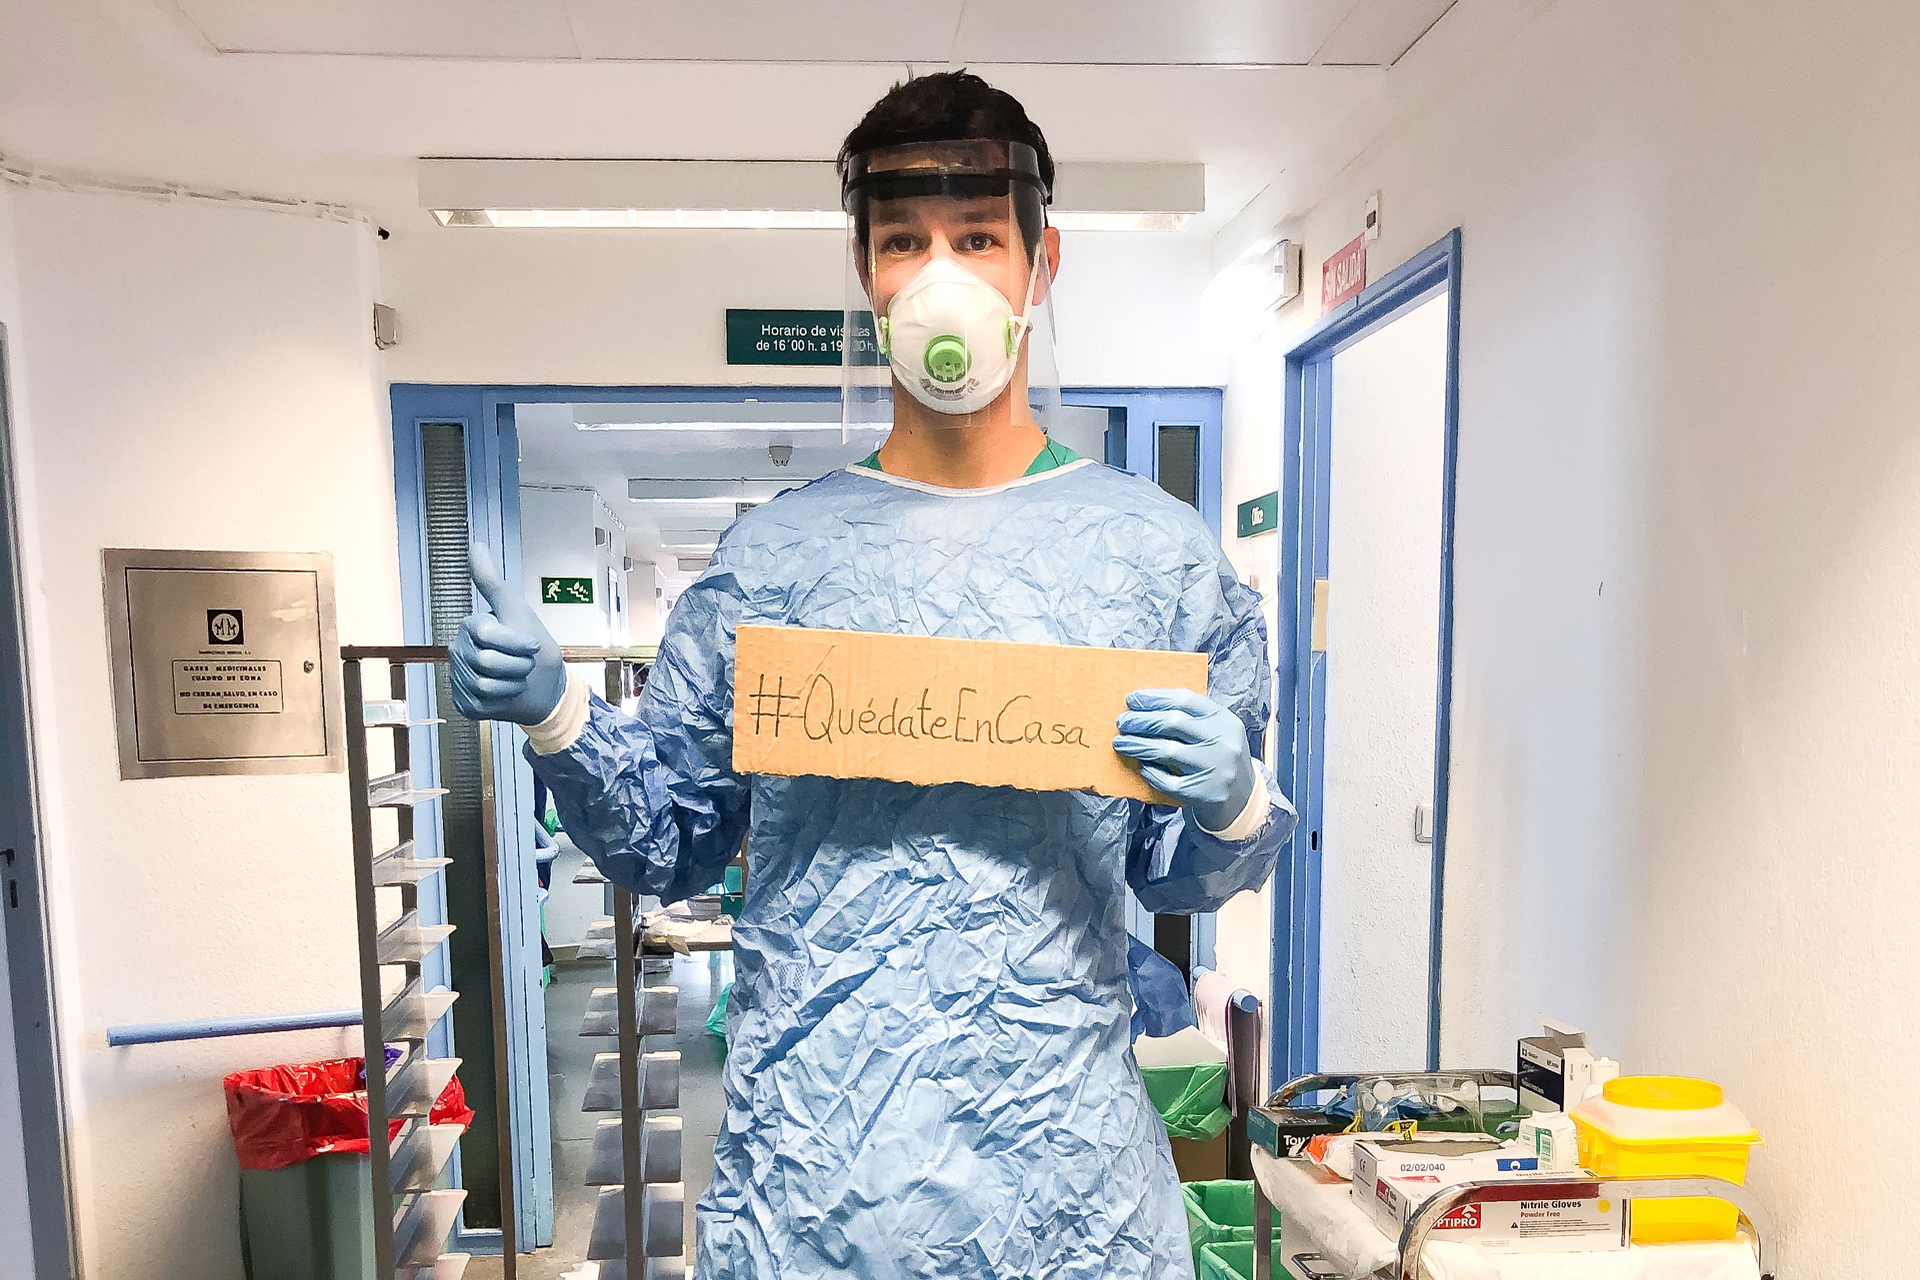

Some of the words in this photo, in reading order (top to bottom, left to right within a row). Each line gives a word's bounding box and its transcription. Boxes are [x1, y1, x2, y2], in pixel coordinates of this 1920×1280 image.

[761, 324, 808, 337] Horario
[810, 325, 827, 337] de
[829, 325, 871, 337] visas
[755, 340, 770, 351] de
[807, 340, 818, 352] h.
[820, 342, 827, 352] a
[750, 673, 1090, 748] #QuédateEnCasa
[1400, 1163, 1446, 1172] 02/02/040
[1520, 1200, 1550, 1209] Nitrile
[1551, 1200, 1582, 1209] Gloves
